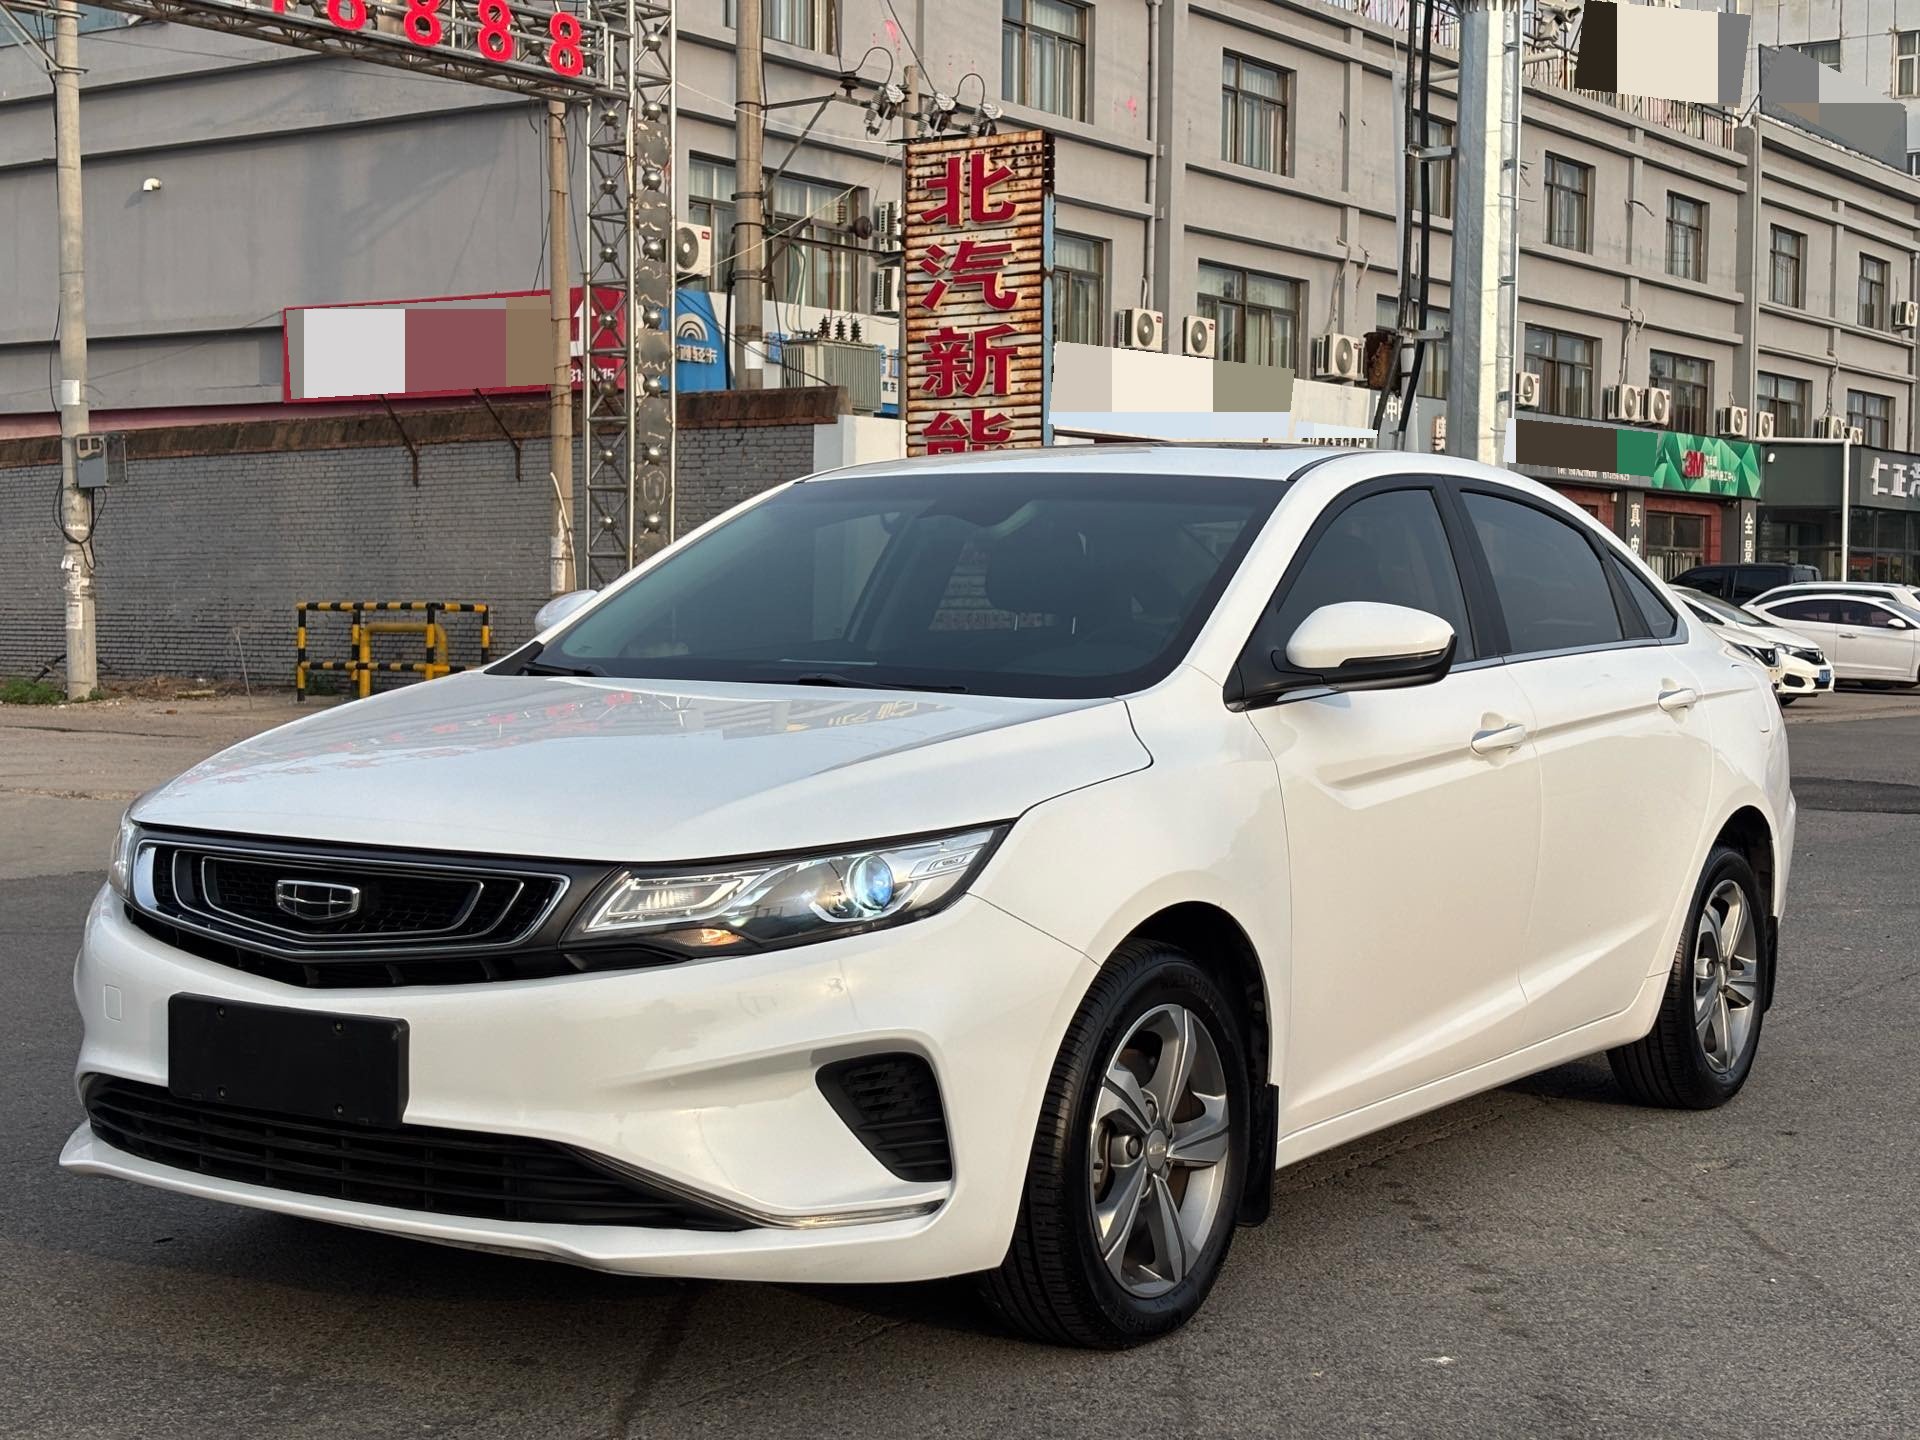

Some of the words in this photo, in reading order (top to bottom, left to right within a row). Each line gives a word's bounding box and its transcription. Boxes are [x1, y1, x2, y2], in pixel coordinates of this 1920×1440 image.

[272, 0, 584, 77] 888
[919, 153, 1022, 455] 北汽新能
[1681, 450, 1705, 479] 3M
